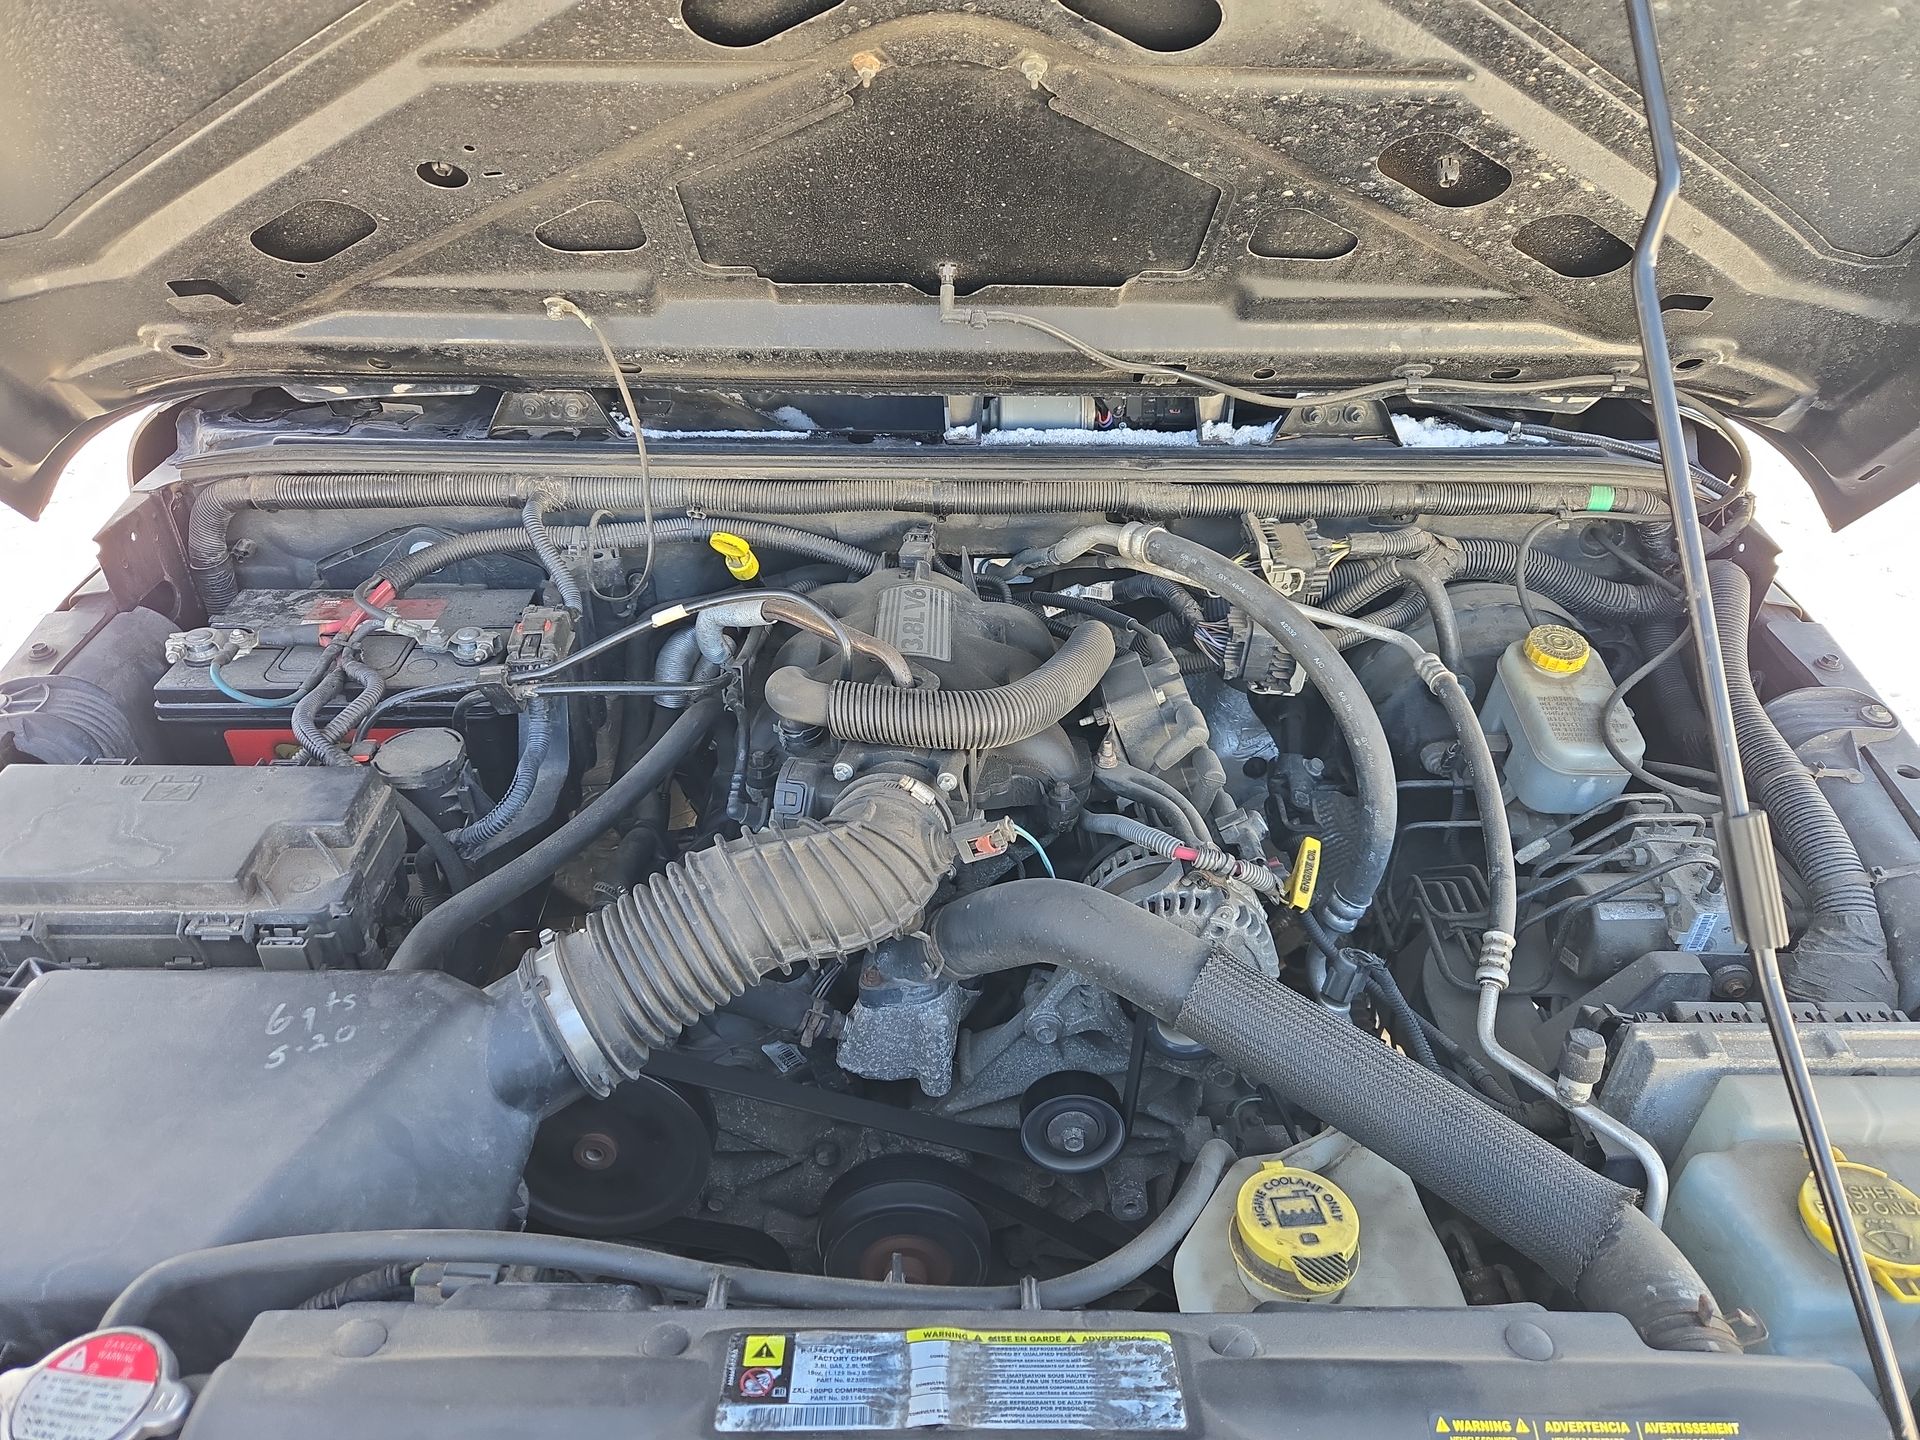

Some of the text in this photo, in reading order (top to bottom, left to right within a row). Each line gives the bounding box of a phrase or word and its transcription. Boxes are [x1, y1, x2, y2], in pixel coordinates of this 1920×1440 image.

[901, 588, 926, 650] 3.8L V6
[1300, 849, 1317, 894] ENGINE OIL
[1253, 1176, 1344, 1228] ENGINE COOLANT ONLY
[923, 1330, 968, 1341] WARNING
[987, 1335, 1012, 1343] MISE
[1014, 1335, 1027, 1343] EN
[1029, 1335, 1062, 1343] GARDE
[1452, 1419, 1740, 1435] WARNING ADVERTENCIA AVERTISSEMENT
